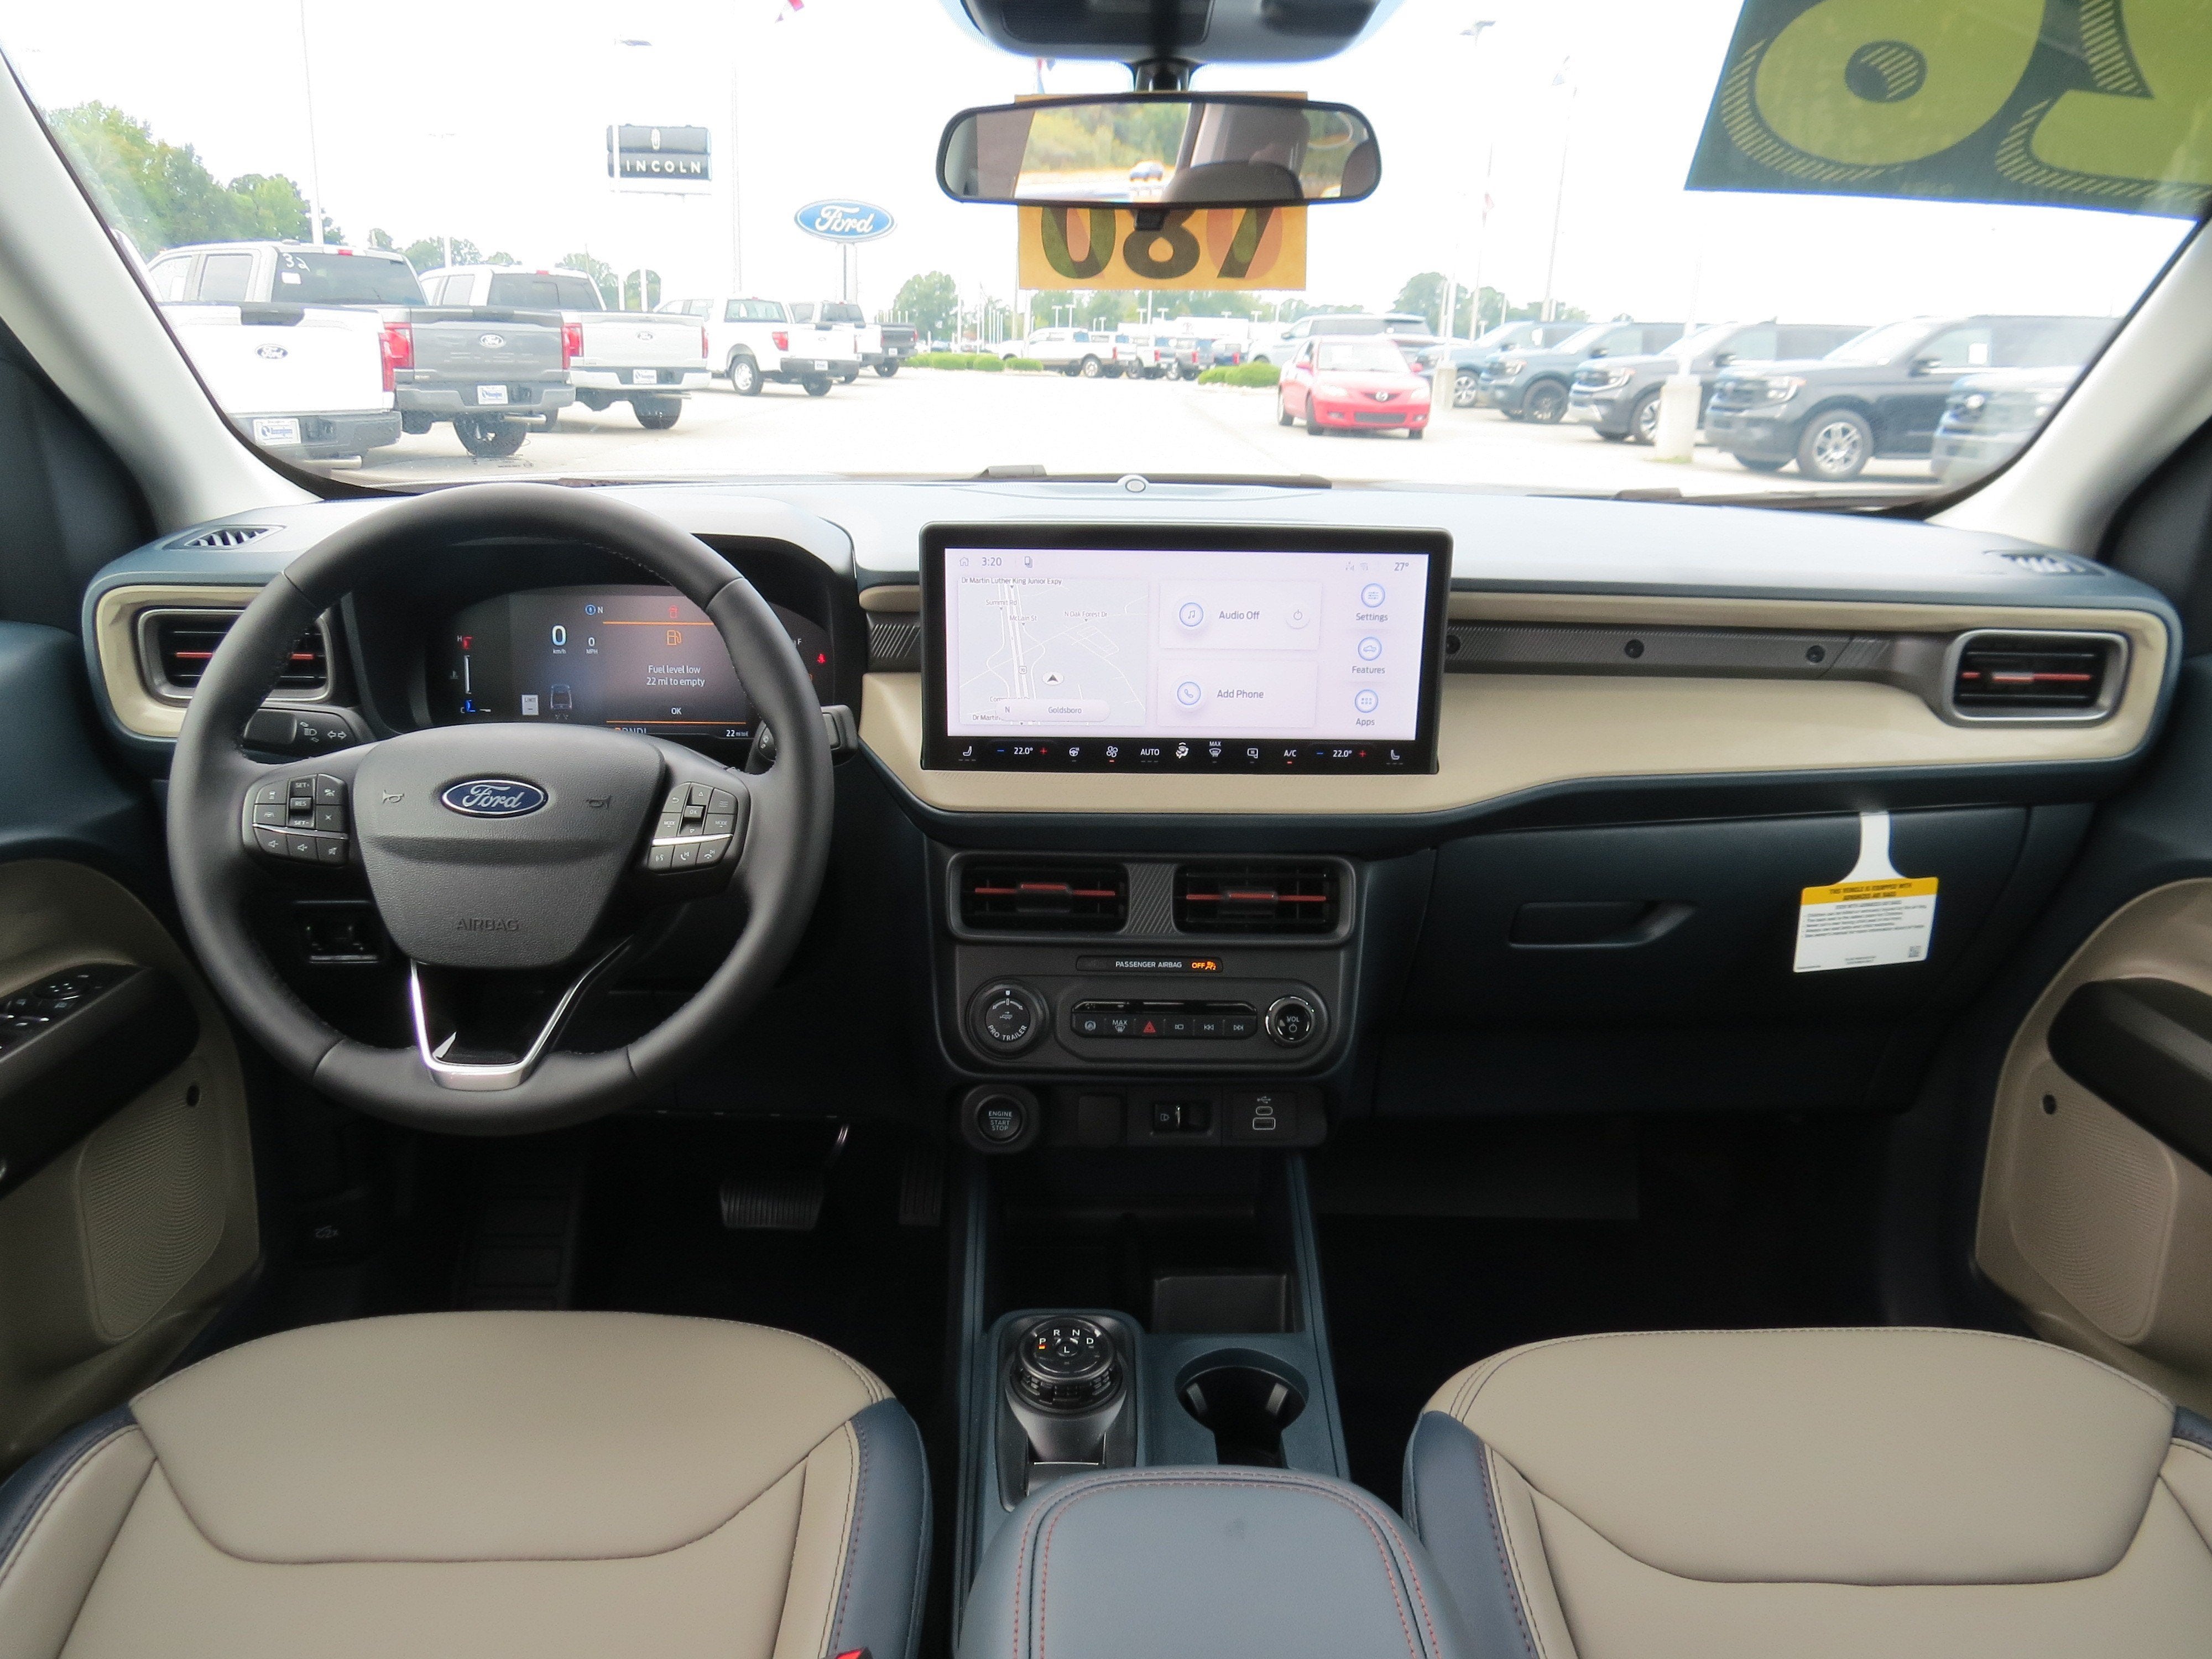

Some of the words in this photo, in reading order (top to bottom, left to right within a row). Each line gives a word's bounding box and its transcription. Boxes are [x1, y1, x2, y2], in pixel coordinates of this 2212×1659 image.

[625, 160, 702, 174] INCOLN
[815, 205, 874, 234] Ford
[981, 556, 1003, 567] 3:20
[1394, 561, 1410, 572] 27°
[969, 576, 990, 585] Martin
[1013, 577, 1026, 586] King
[1218, 610, 1245, 620] Audio
[1246, 610, 1261, 620] Off
[1355, 612, 1388, 623] Settings
[551, 625, 567, 646] 0
[588, 637, 595, 646] 0
[648, 665, 665, 674] Fuel
[666, 665, 685, 674] level
[686, 665, 701, 674] low
[1352, 665, 1386, 674] Features
[646, 677, 656, 686] 22
[658, 677, 668, 686] mi
[670, 677, 679, 686] to
[680, 678, 706, 687] empty
[1217, 689, 1235, 698] Add
[1236, 689, 1264, 699] Phone
[1047, 706, 1082, 714] Goldsboro
[1355, 718, 1375, 727] Apps
[1014, 747, 1034, 755] 22.0°
[462, 783, 522, 809] Ford
[456, 916, 520, 932] AIRBAG
[988, 1024, 1000, 1038] PRO
[1002, 1025, 1027, 1041] TRAILER
